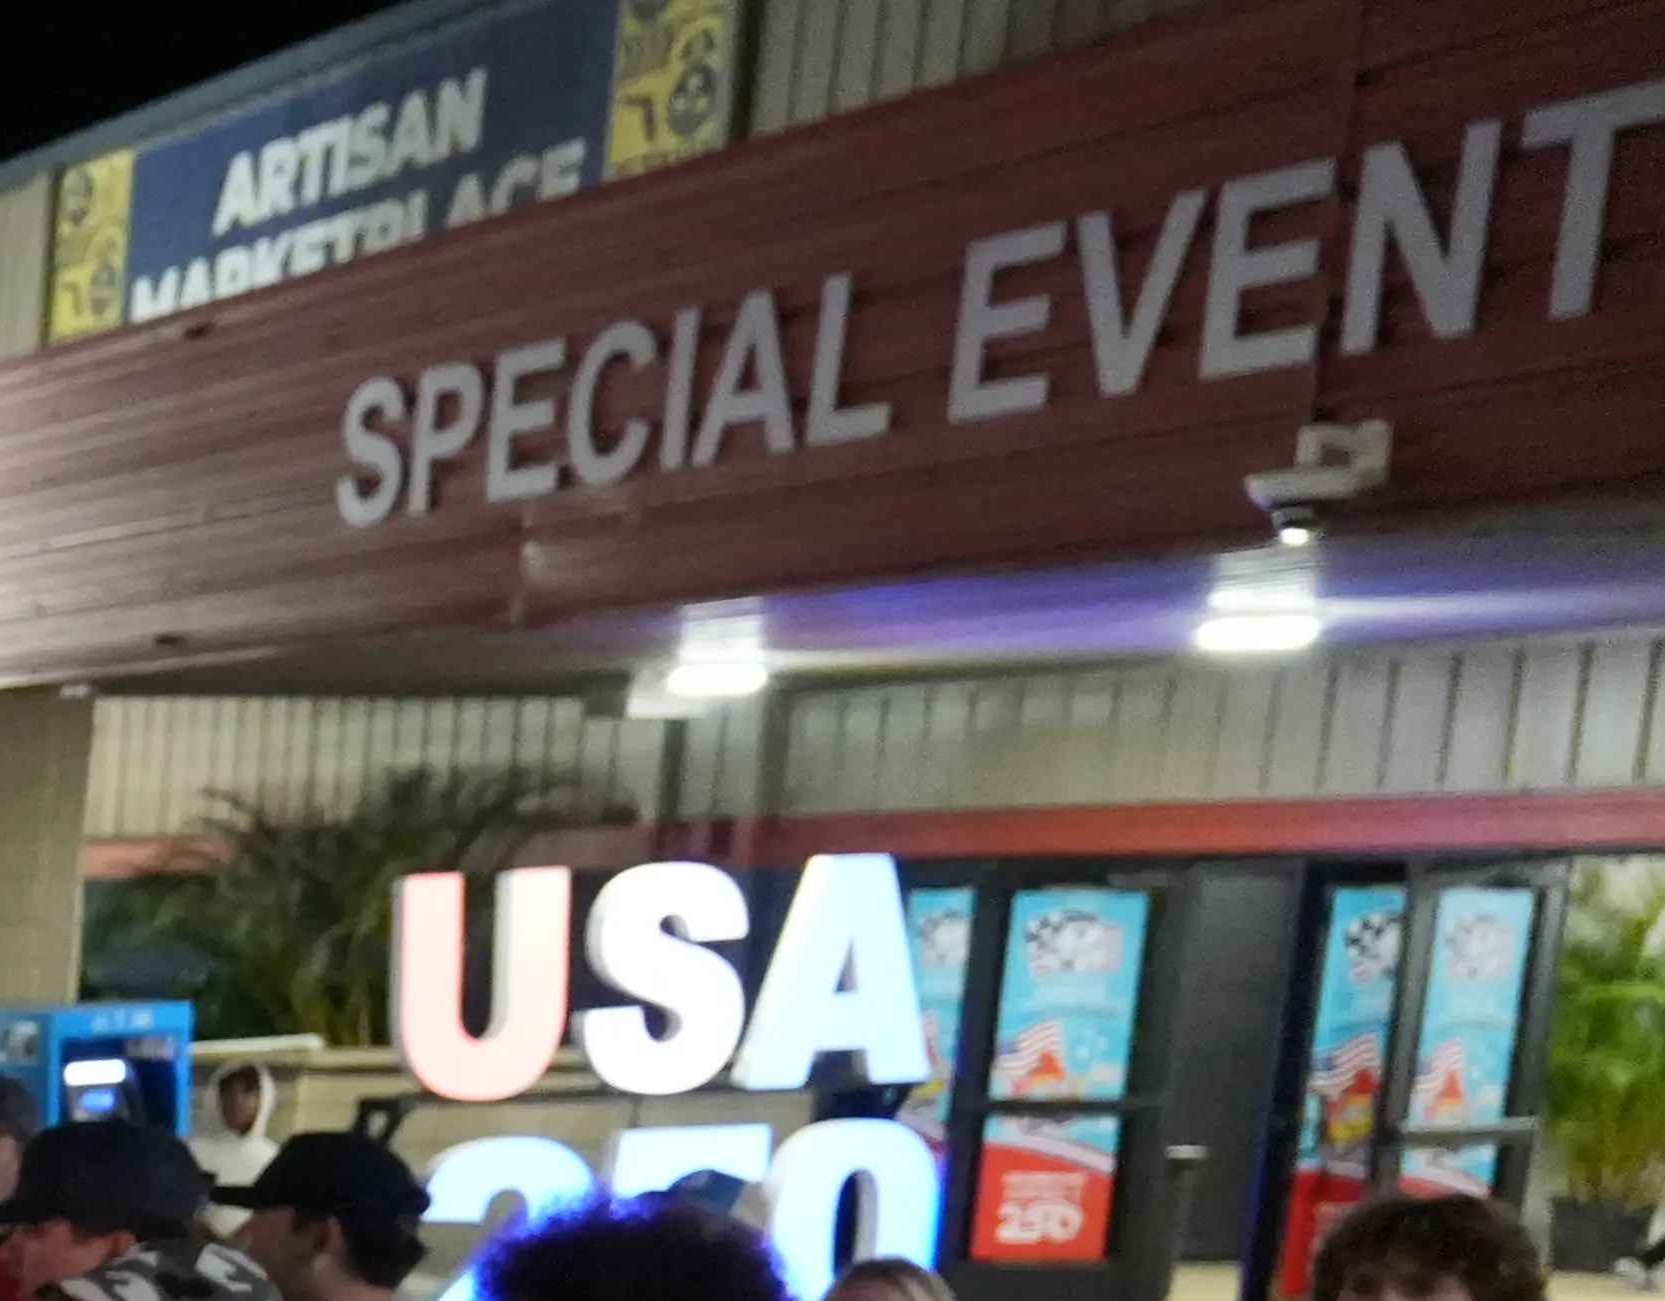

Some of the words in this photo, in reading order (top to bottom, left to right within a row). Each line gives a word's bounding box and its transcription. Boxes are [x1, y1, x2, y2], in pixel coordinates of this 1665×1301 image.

[213, 67, 489, 237] ARTISAN
[335, 273, 893, 528] SPECIAL
[394, 852, 932, 1101] USA
[995, 1202, 1085, 1245] 250
